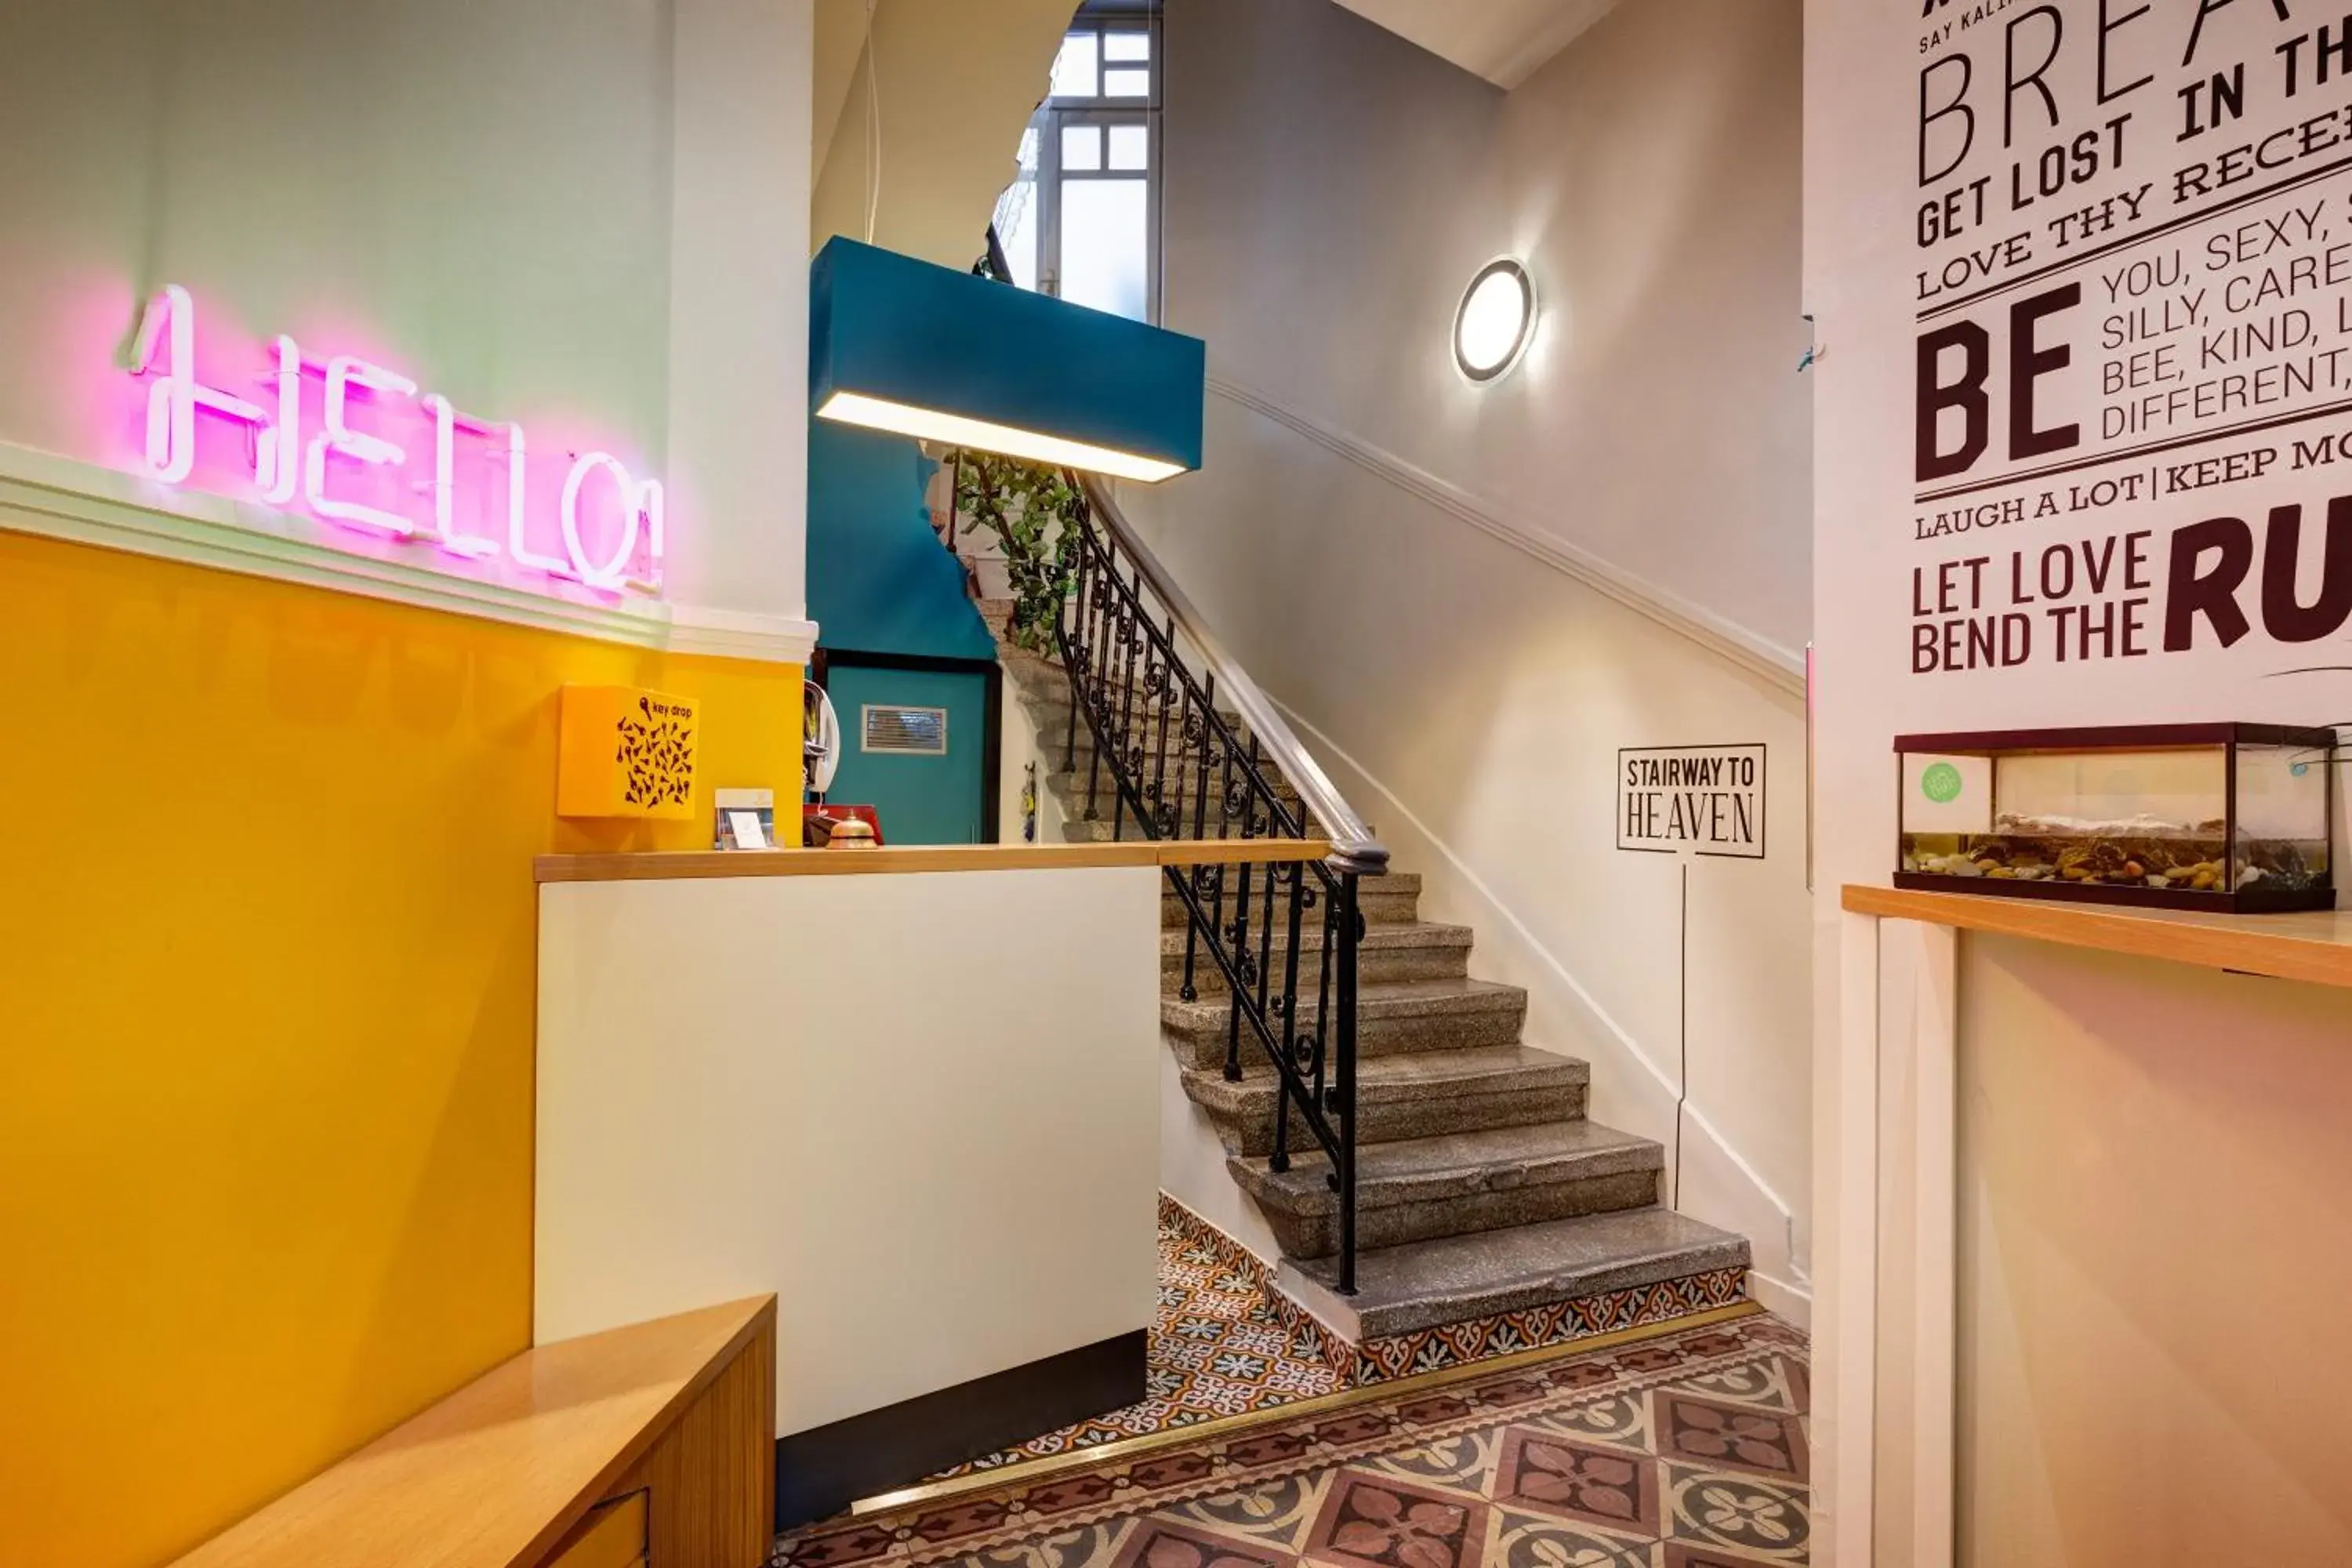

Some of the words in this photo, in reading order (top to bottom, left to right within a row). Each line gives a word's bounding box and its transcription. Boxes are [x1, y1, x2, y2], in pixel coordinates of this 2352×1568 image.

[1919, 22, 1952, 54] SAY
[1961, 0, 2012, 31] KALI
[1917, 176, 1991, 249] GET
[2012, 113, 2132, 212] LOST
[2176, 63, 2245, 143] IN
[1917, 231, 2032, 301] LOVE
[2049, 183, 2154, 249] THY
[2173, 104, 2352, 205] RECE
[2102, 250, 2190, 303] YOU,
[2205, 200, 2328, 271] SEXY,
[2102, 289, 2209, 350] SILLY,
[2103, 345, 2183, 396] BEE,
[2201, 310, 2318, 369] KIND,
[1916, 282, 2082, 483] BE
[2103, 348, 2351, 440] DIFFERENT,
[131, 284, 663, 590] HELLO
[1915, 498, 2025, 539] LAUGH
[2034, 492, 2060, 518] A
[1913, 557, 1990, 617] LET
[2012, 530, 2152, 604] LOVE
[1912, 613, 2031, 673] BEND
[2046, 597, 2149, 662] THE
[652, 702, 669, 717] key
[671, 704, 691, 720] drop
[1627, 757, 1723, 786] STAIRWAY
[1727, 757, 1754, 787] TO
[1626, 792, 1754, 844] HEAVEN
